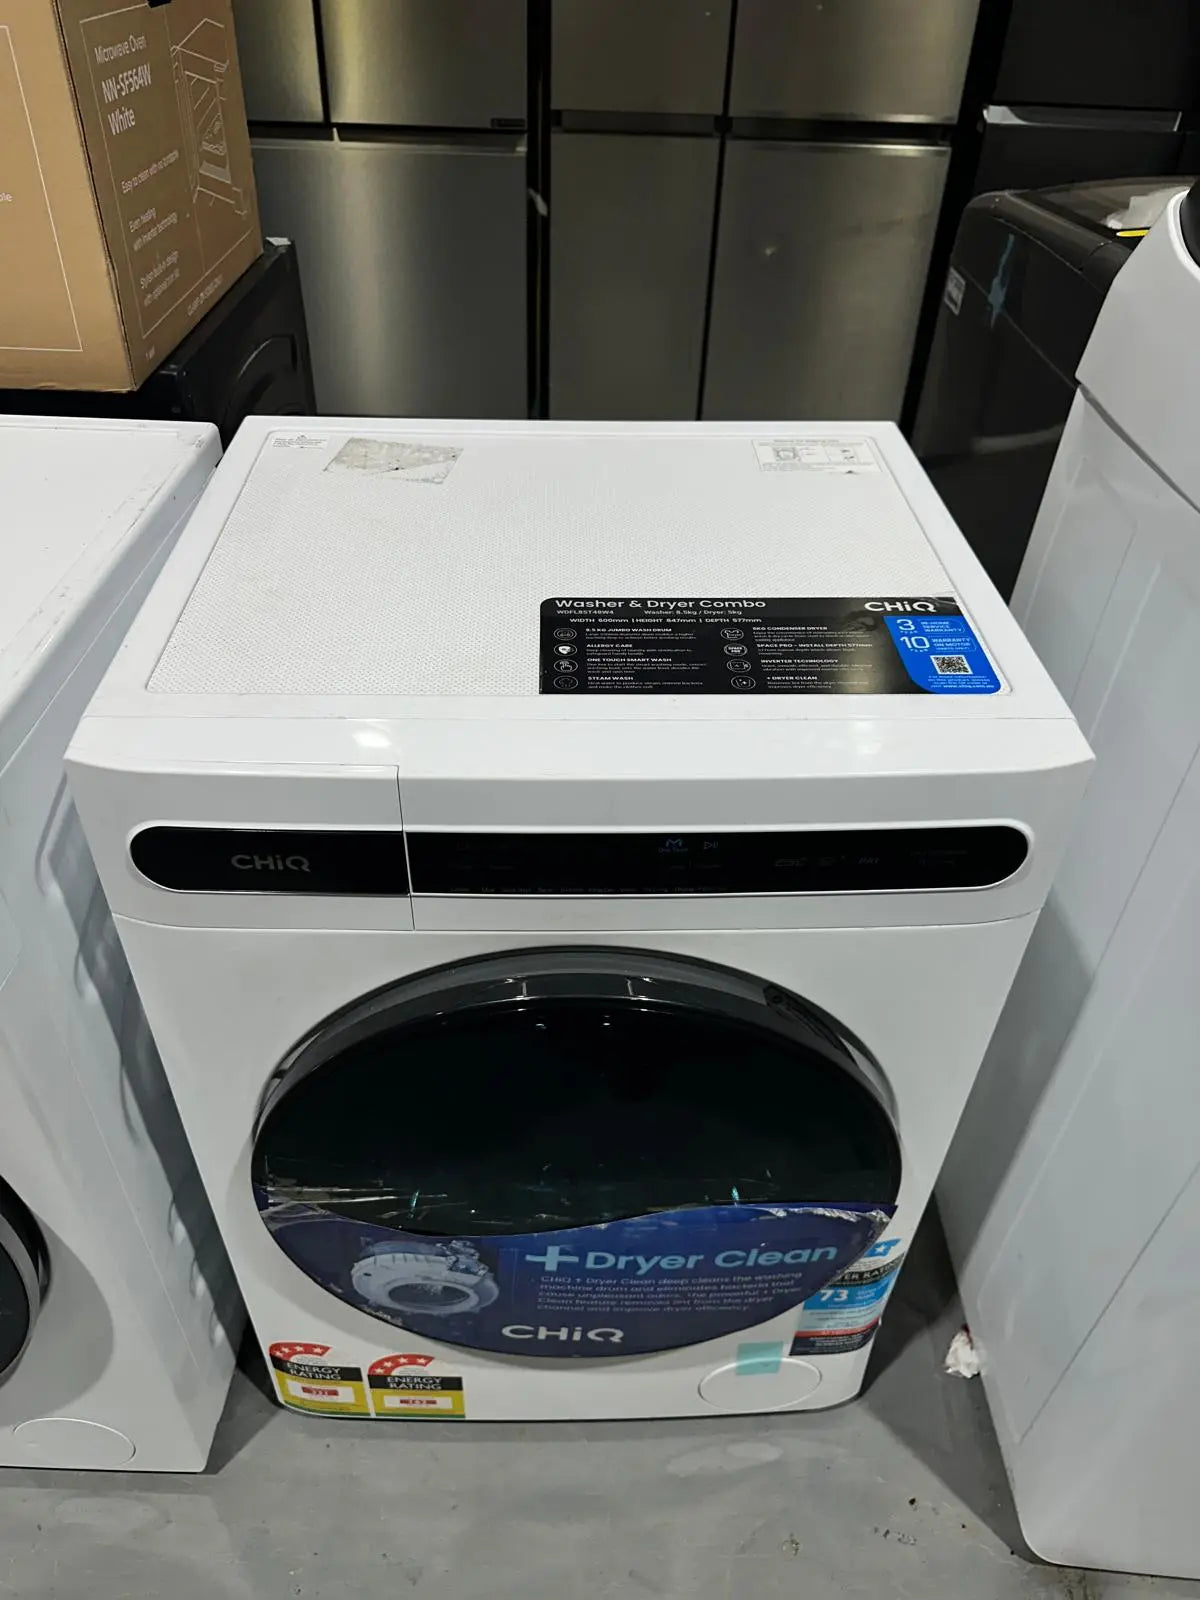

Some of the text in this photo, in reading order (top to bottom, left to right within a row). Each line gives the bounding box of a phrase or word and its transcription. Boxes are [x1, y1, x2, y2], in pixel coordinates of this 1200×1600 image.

[94, 34, 146, 64] Microwave Oven
[102, 63, 152, 104] NN-SF564W
[108, 106, 136, 136] White
[555, 600, 624, 608] Washer
[647, 600, 694, 610] Dryer
[700, 600, 766, 608] Combo
[864, 601, 937, 612] CHiQ
[896, 619, 916, 631] 3
[900, 636, 930, 649] 10
[231, 854, 311, 872] CHiQ
[585, 1251, 704, 1276] Dryer
[714, 1246, 838, 1268] Clean
[820, 1290, 848, 1302] 73
[502, 1326, 624, 1344] CHiQ
[287, 1362, 340, 1374] ENERGY
[290, 1369, 342, 1380] RATING
